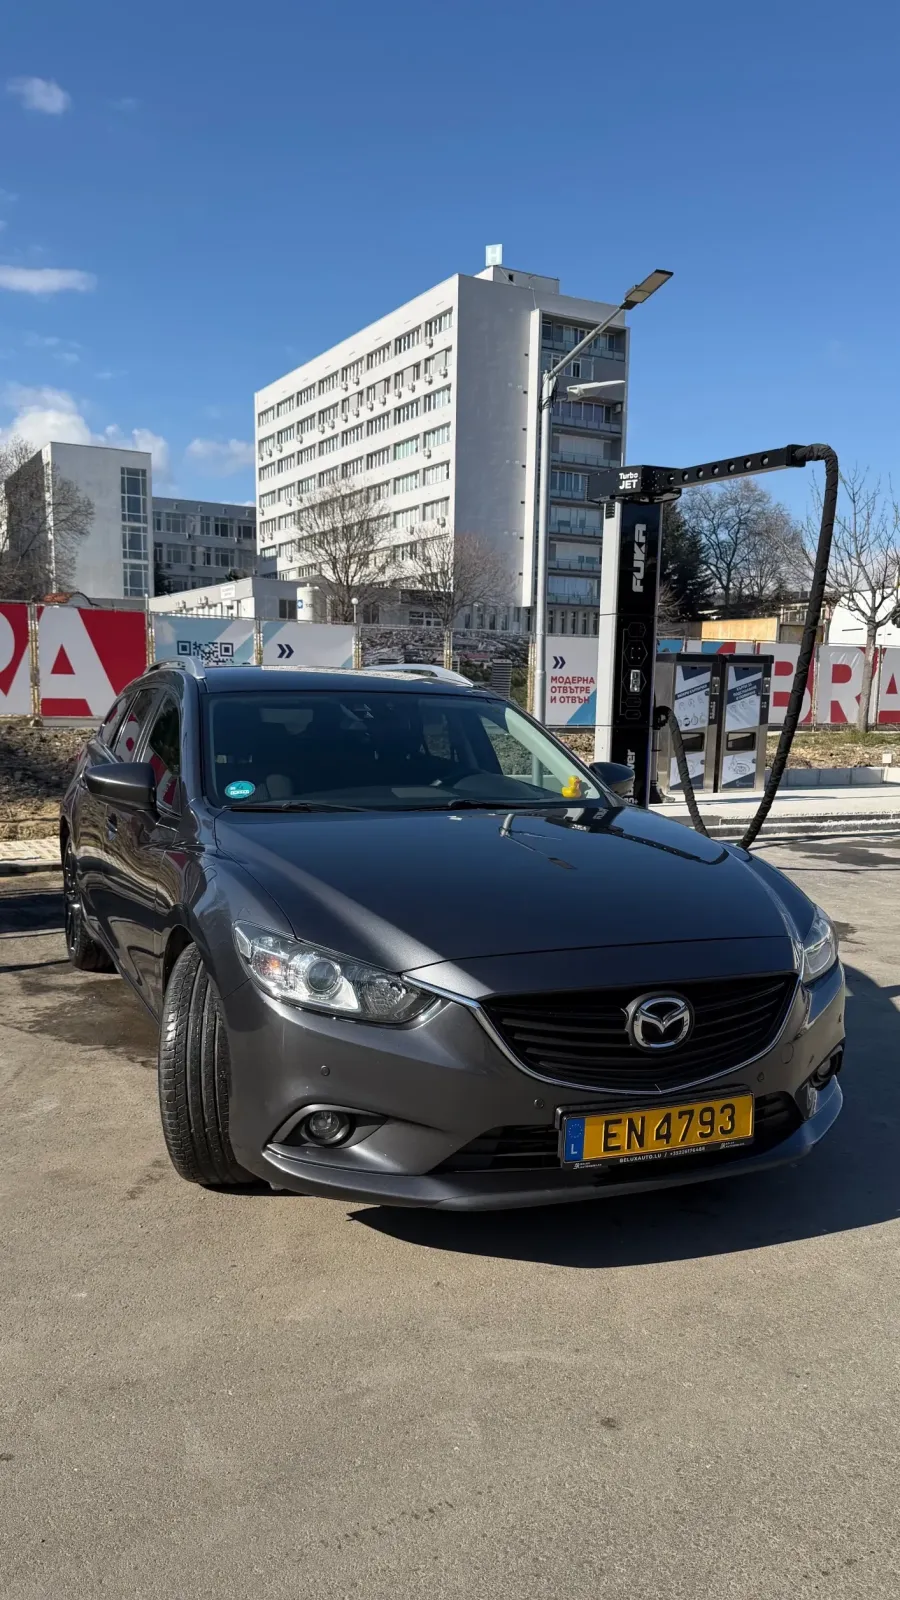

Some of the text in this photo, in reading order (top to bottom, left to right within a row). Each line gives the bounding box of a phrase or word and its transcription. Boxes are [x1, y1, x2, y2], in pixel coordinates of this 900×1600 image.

[619, 472, 639, 480] Turbo
[619, 479, 639, 490] JET
[632, 523, 647, 593] FUKA
[550, 676, 595, 685] МОДЕРНА
[550, 685, 591, 694] ОТВЪТРЕ
[550, 695, 590, 704] И ОТВЪН
[570, 1103, 736, 1154] L EN 4793
[620, 1153, 662, 1163] BELUXAUTO.LU
